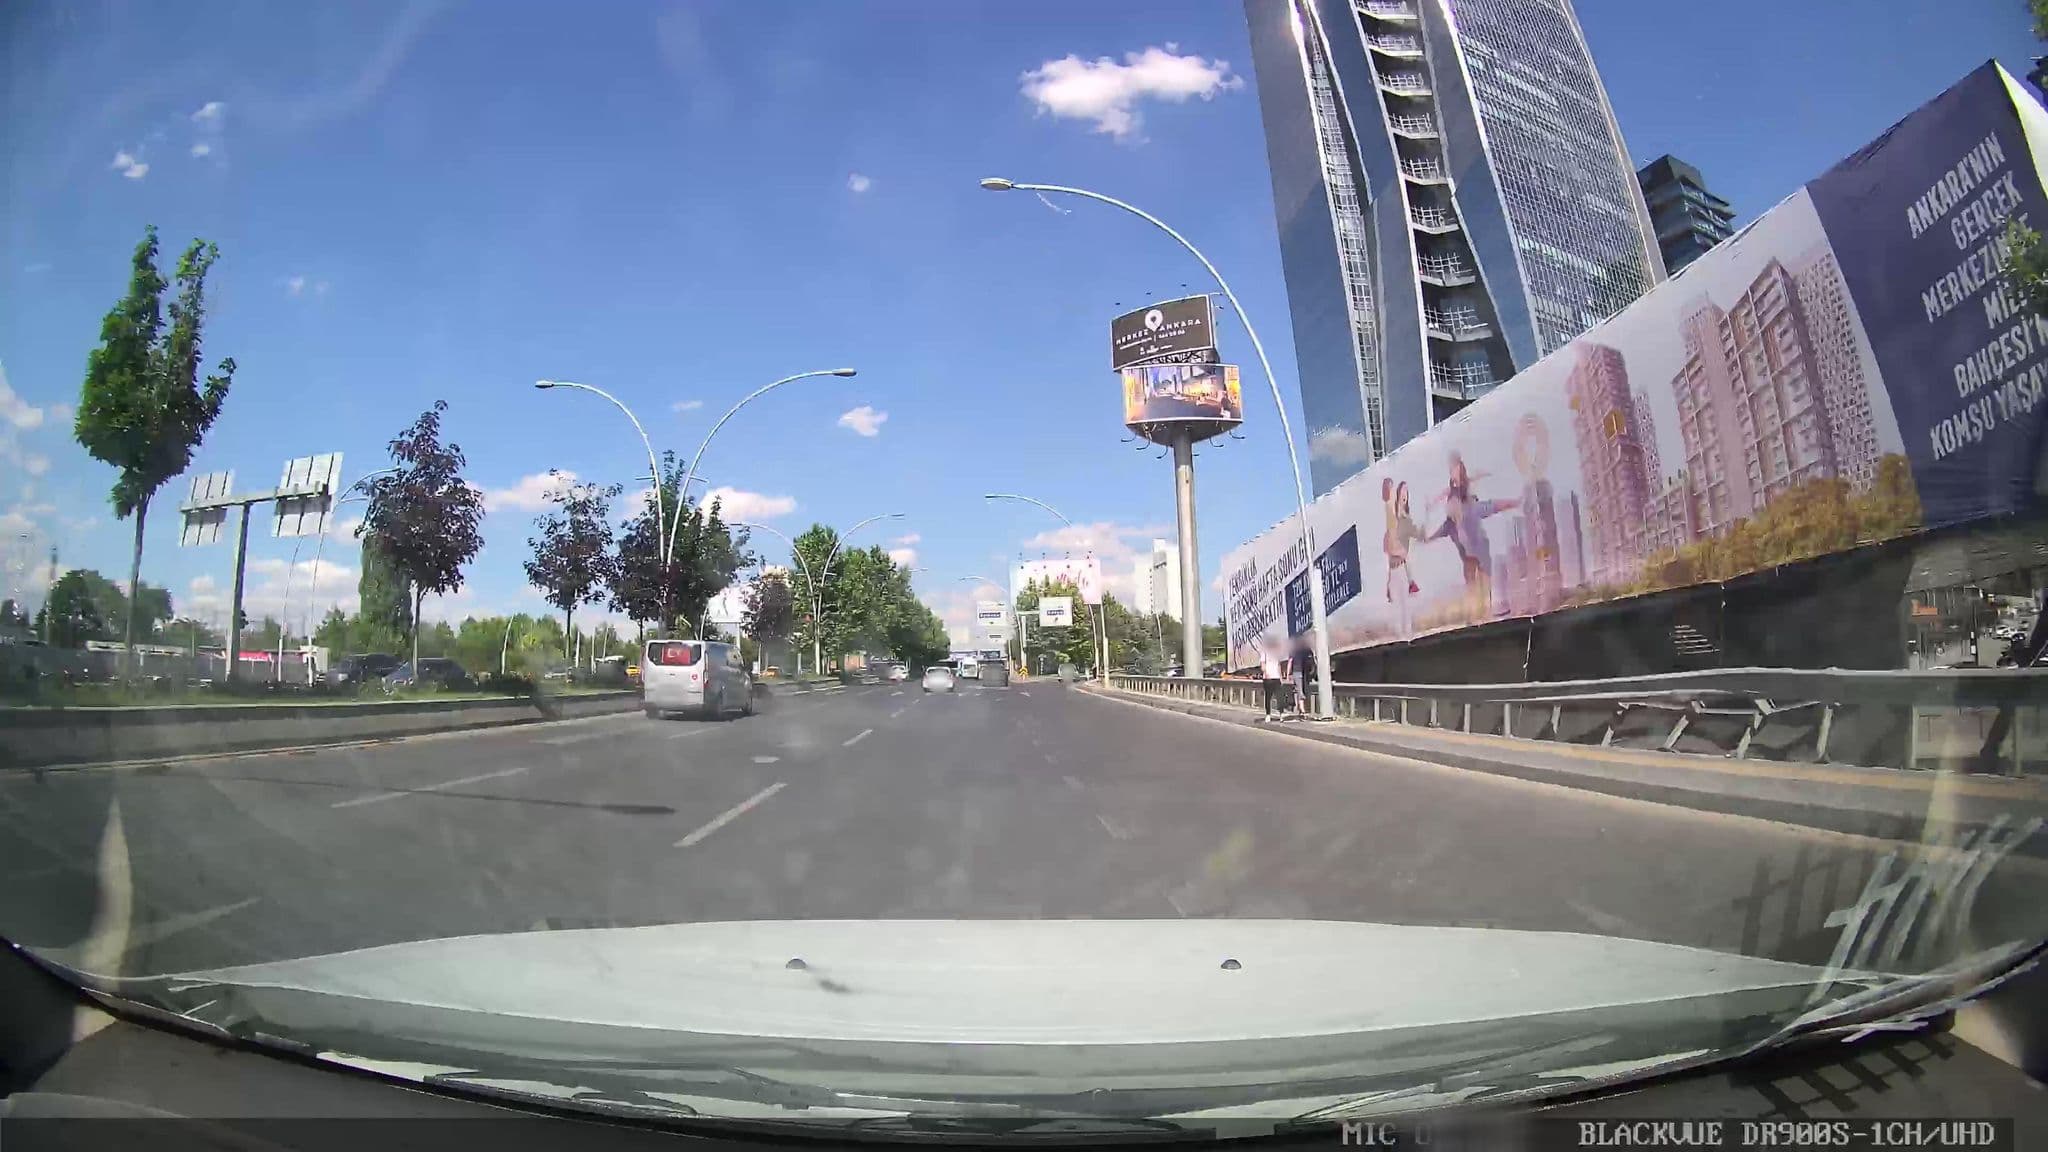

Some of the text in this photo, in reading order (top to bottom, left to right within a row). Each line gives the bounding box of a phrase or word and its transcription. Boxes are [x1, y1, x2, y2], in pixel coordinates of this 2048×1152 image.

[1906, 131, 2006, 239] ANKARA'NIN
[1951, 170, 2023, 250] GERÇEK
[1158, 318, 1201, 331] ANKARA
[1257, 565, 1279, 602] HAFTA
[1278, 544, 1298, 582] SONU
